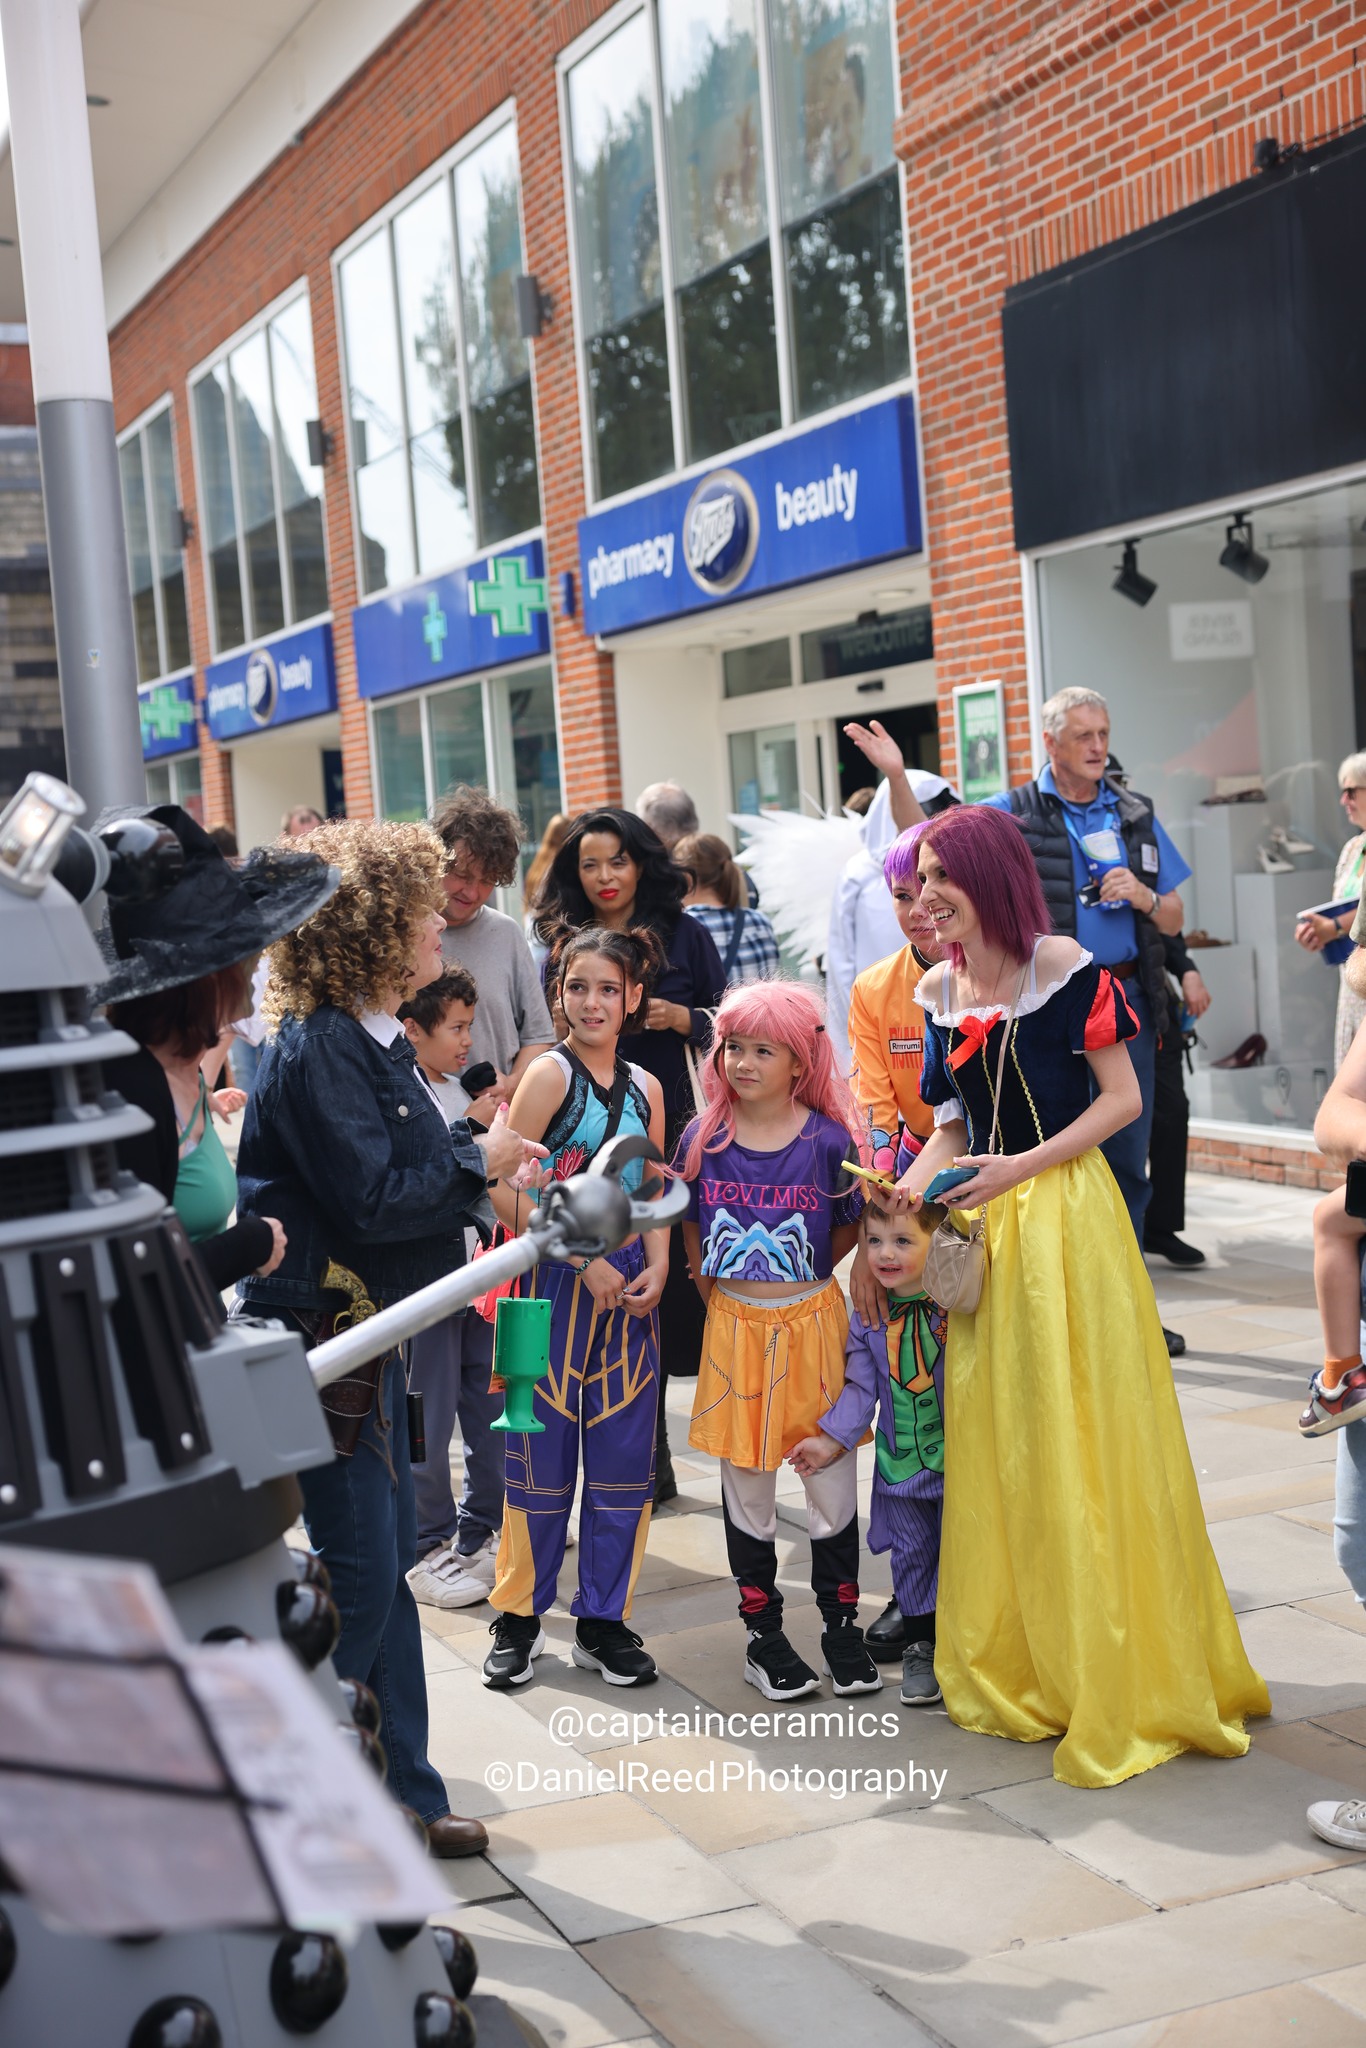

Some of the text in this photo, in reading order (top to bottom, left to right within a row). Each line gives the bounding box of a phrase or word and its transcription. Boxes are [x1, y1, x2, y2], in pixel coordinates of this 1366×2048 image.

[587, 532, 675, 599] pharmacy
[775, 463, 858, 532] beauty
[772, 1187, 819, 1210] MISS
